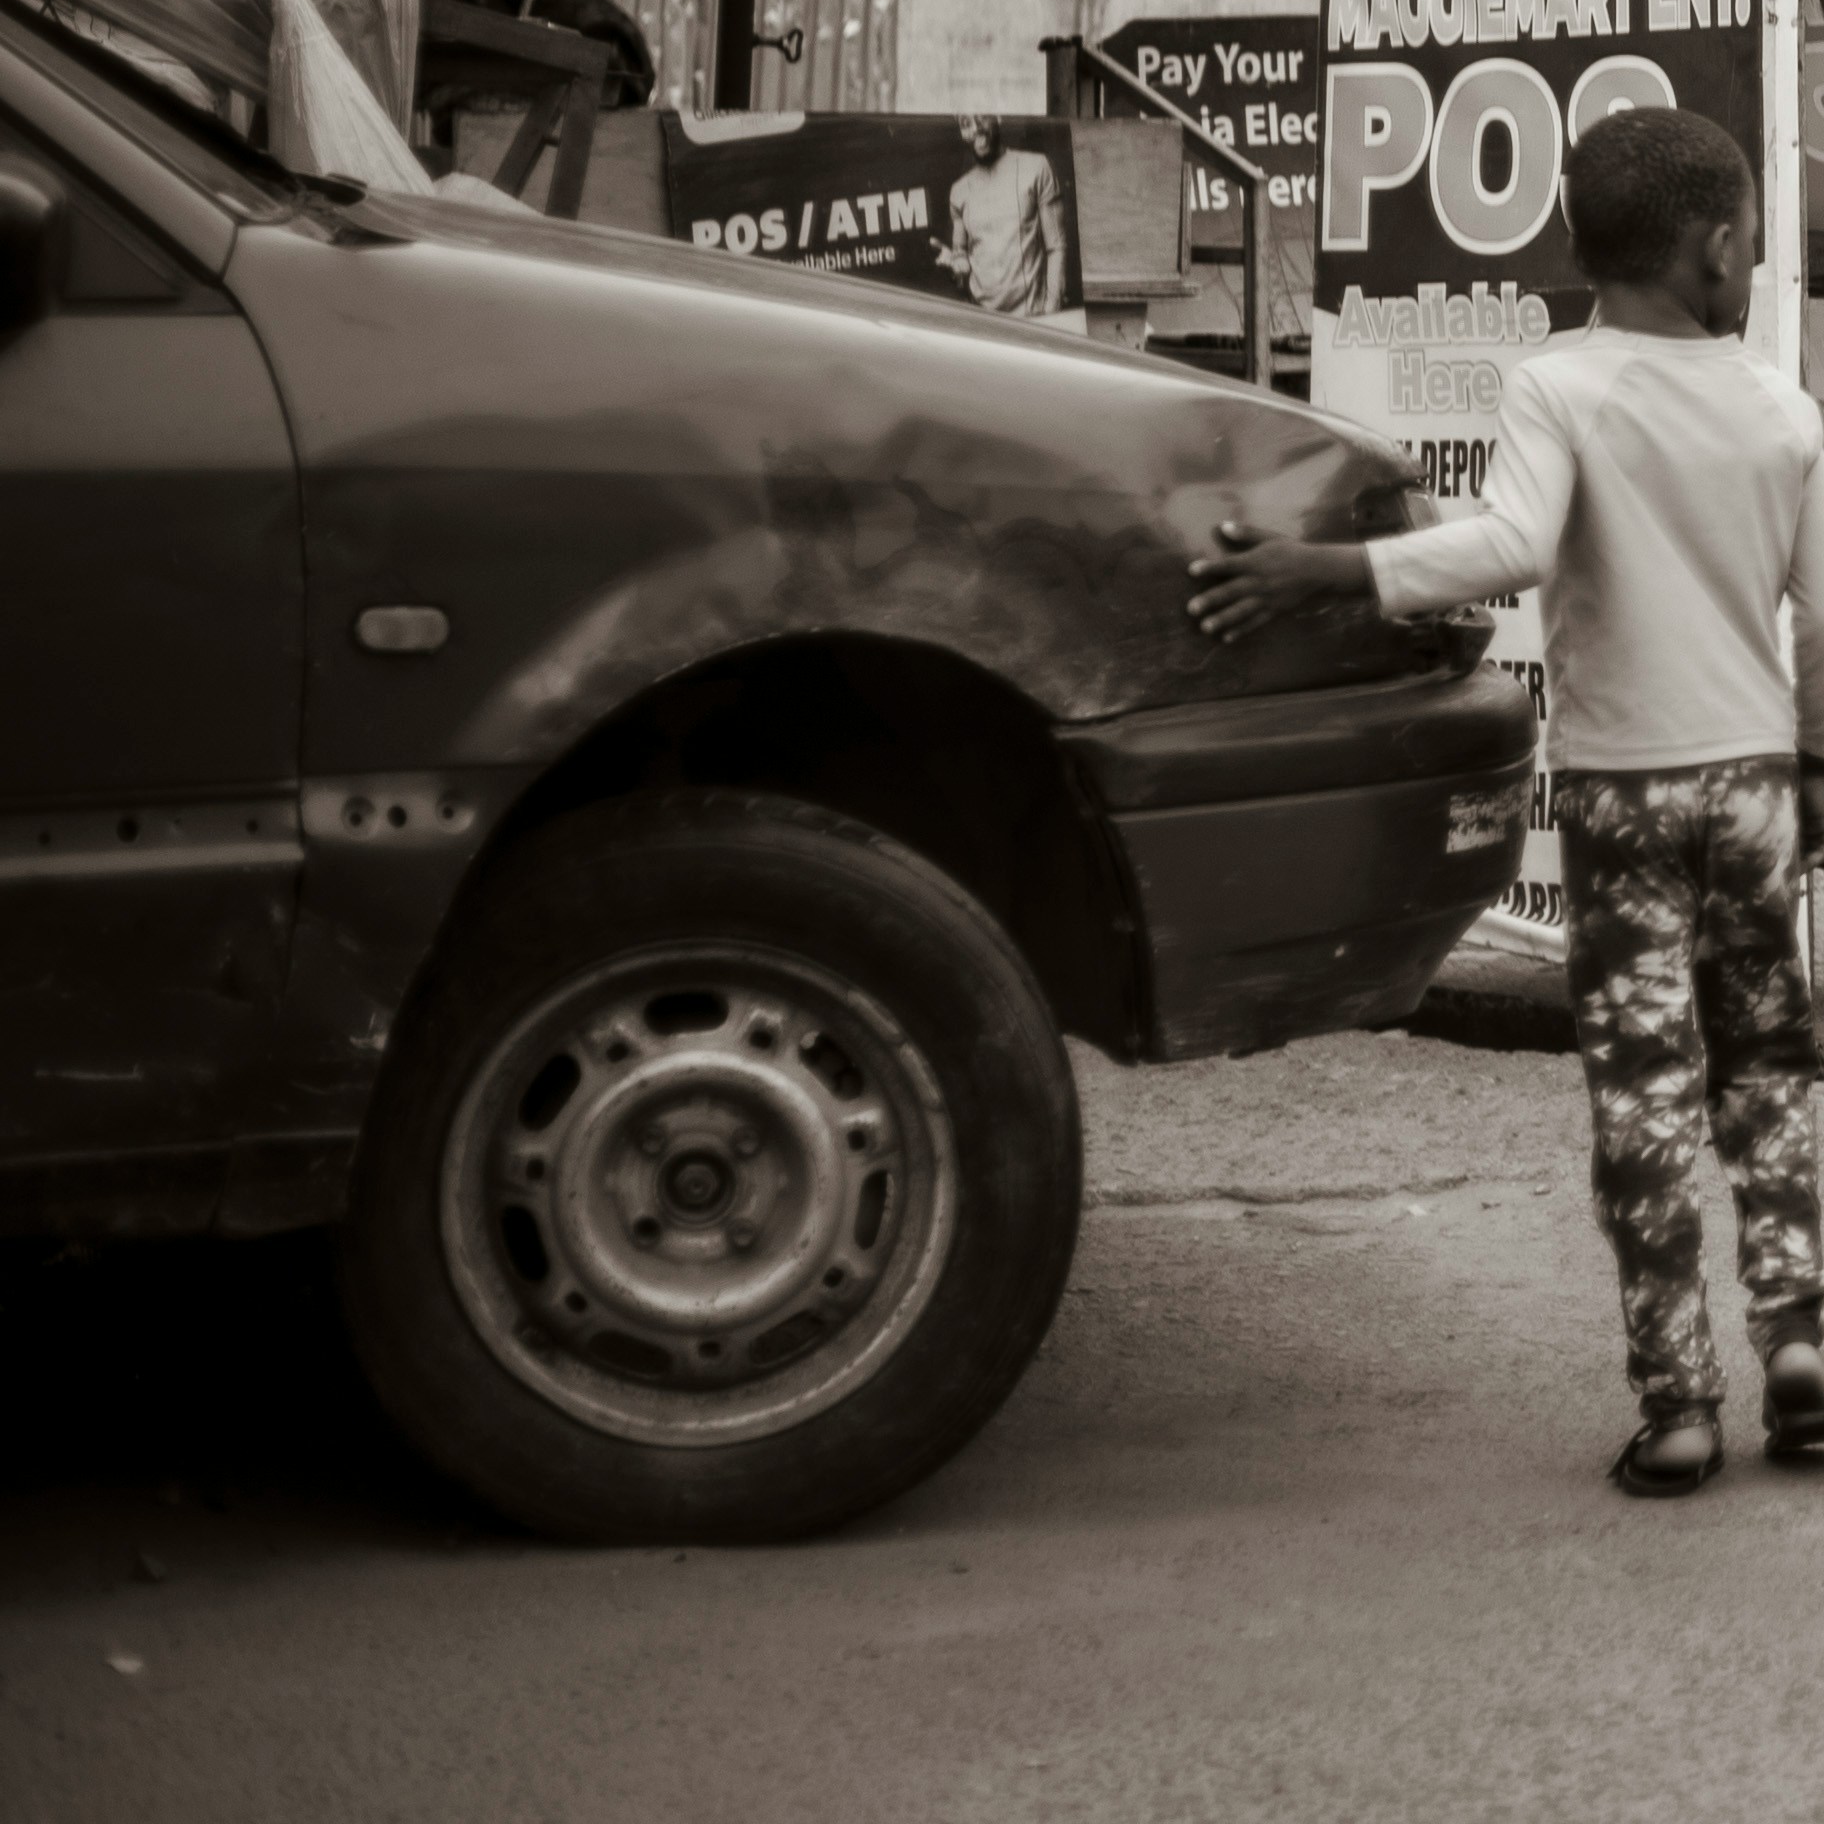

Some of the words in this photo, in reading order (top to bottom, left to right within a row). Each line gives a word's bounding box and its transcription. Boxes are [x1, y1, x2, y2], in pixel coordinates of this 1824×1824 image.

[1137, 45, 1207, 98] Pay
[1213, 42, 1304, 85] Your
[691, 208, 789, 254] POS
[826, 187, 929, 242] ATM
[854, 243, 897, 269] Here
[1332, 280, 1553, 349] Available
[1388, 348, 1504, 415] Here
[1420, 437, 1498, 500] DEPO
